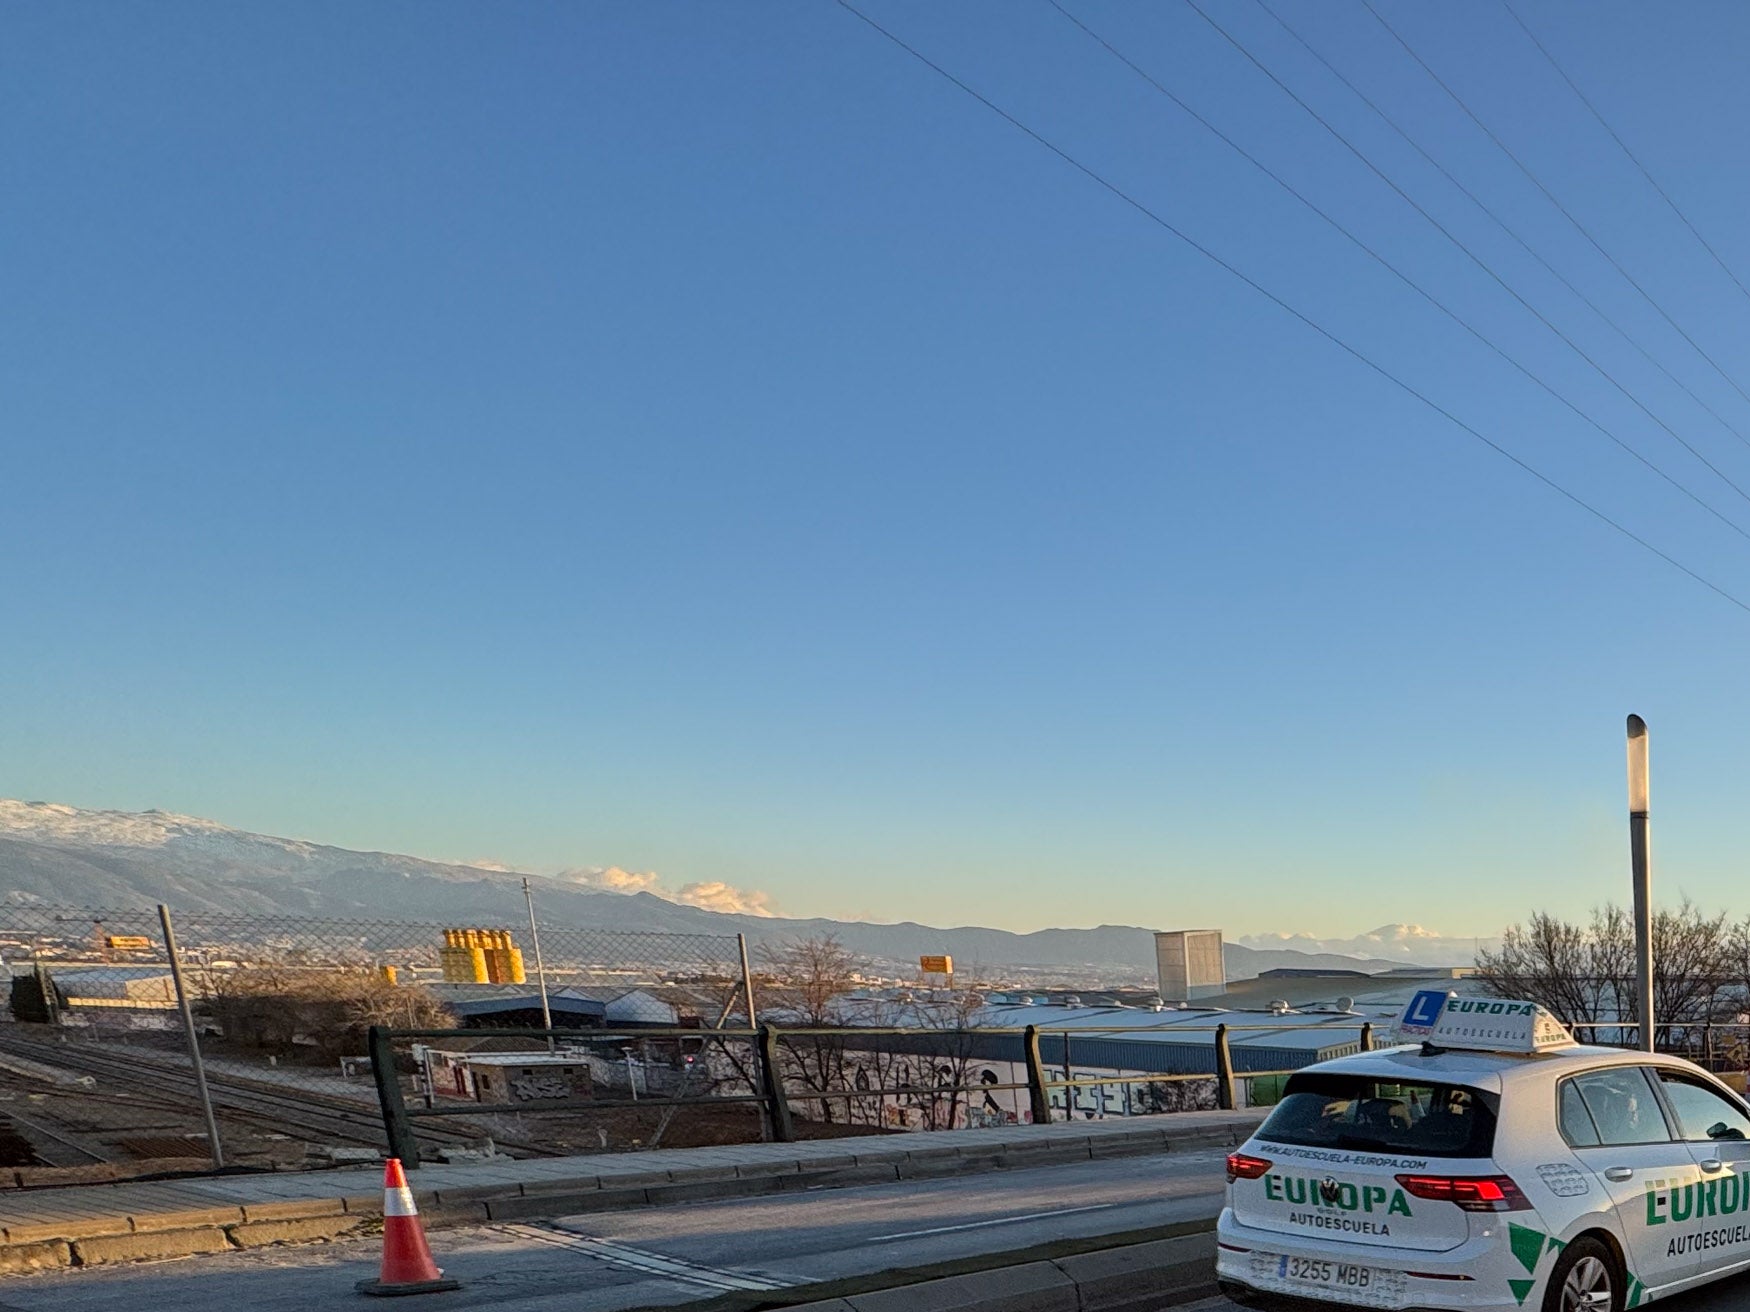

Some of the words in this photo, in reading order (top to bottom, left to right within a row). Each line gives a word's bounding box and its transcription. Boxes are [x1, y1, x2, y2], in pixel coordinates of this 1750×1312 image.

[1411, 996, 1429, 1021] L
[1447, 1000, 1532, 1017] EUROPA
[1438, 1026, 1527, 1041] AUTOESCUELA
[1289, 1211, 1391, 1237] AUTOESCUELA
[1290, 1257, 1331, 1282] 3255
[1336, 1263, 1370, 1287] MBB
